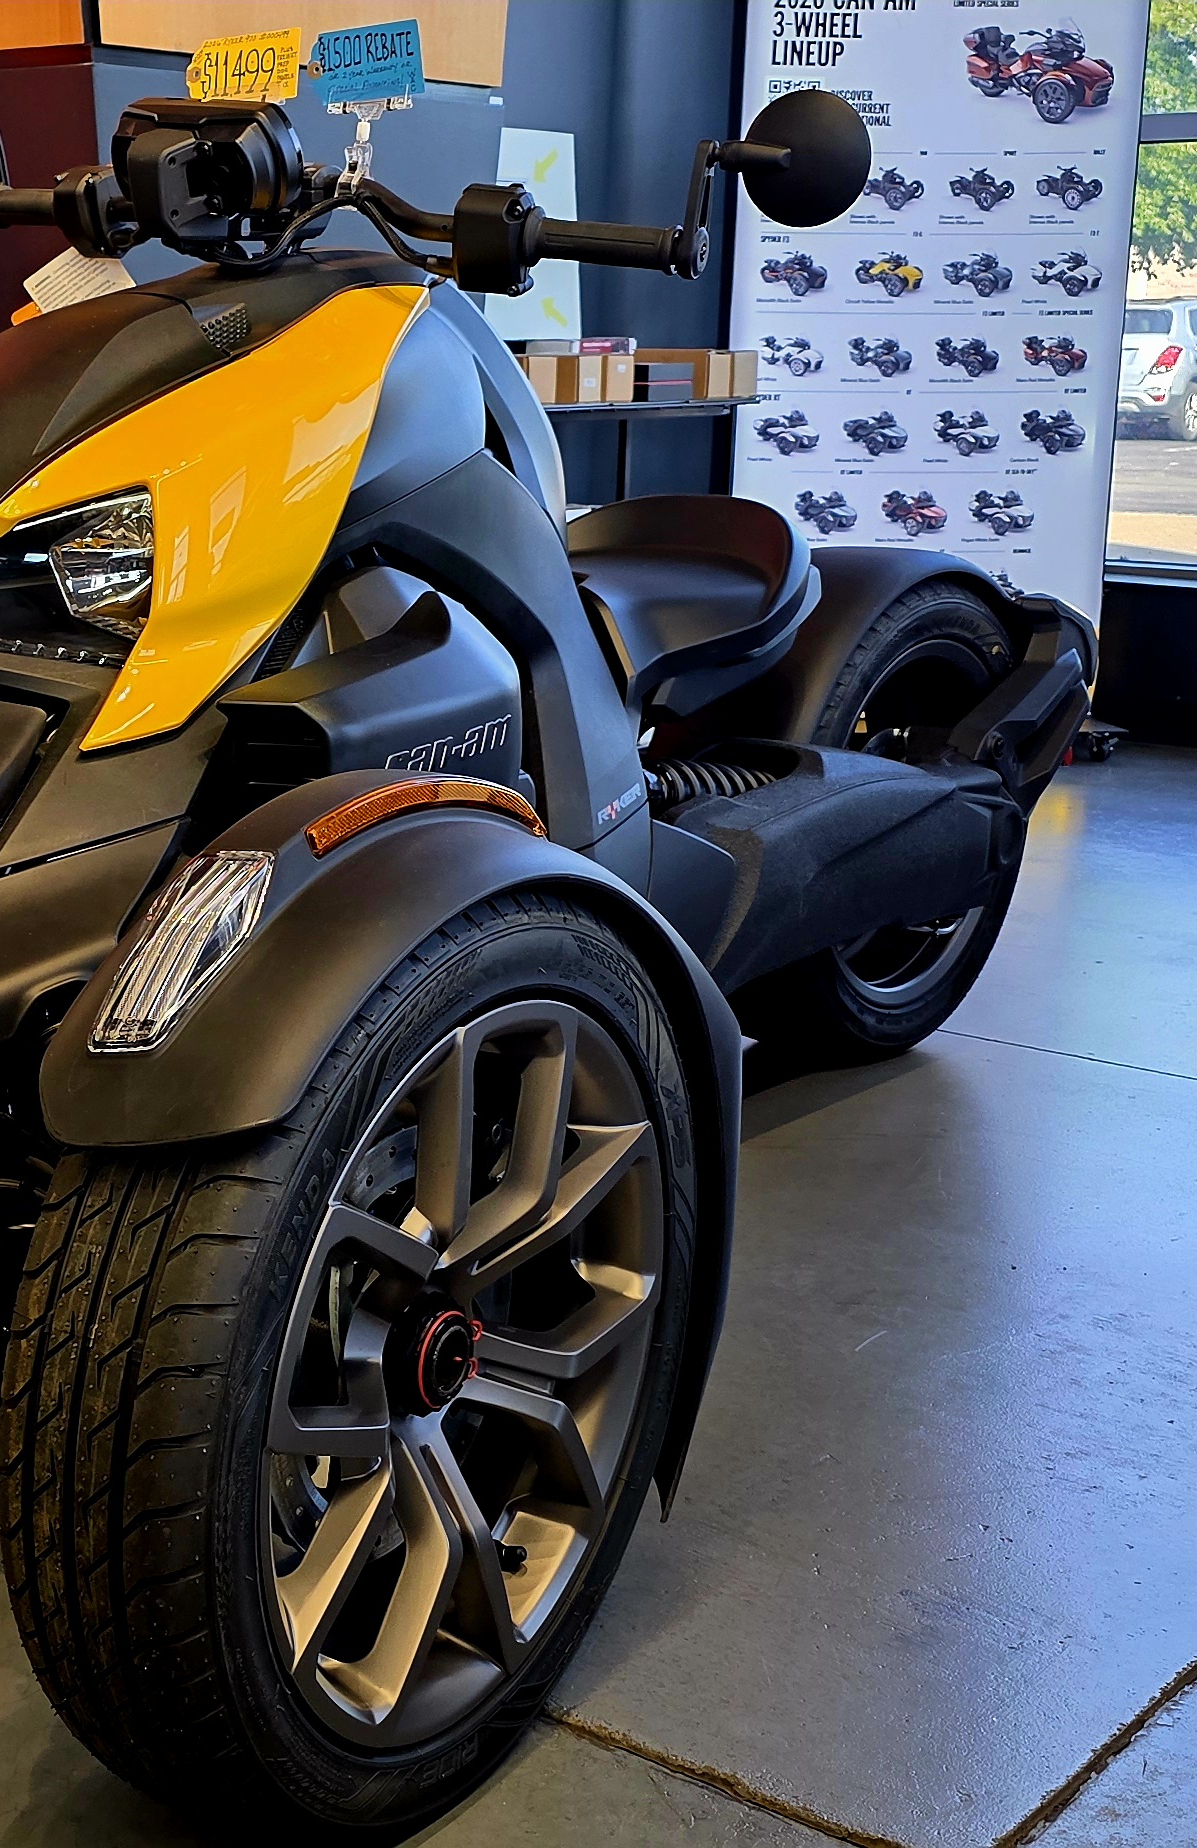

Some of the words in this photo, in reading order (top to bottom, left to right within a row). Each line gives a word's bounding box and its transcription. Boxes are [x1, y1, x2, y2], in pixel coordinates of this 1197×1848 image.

[772, 11, 863, 39] 3-WHEEL
[365, 30, 414, 64] REBATE
[771, 40, 845, 66] LINEUP
[384, 713, 511, 771] can-am
[597, 782, 641, 825] RYKER
[268, 1147, 336, 1303] KENDA
